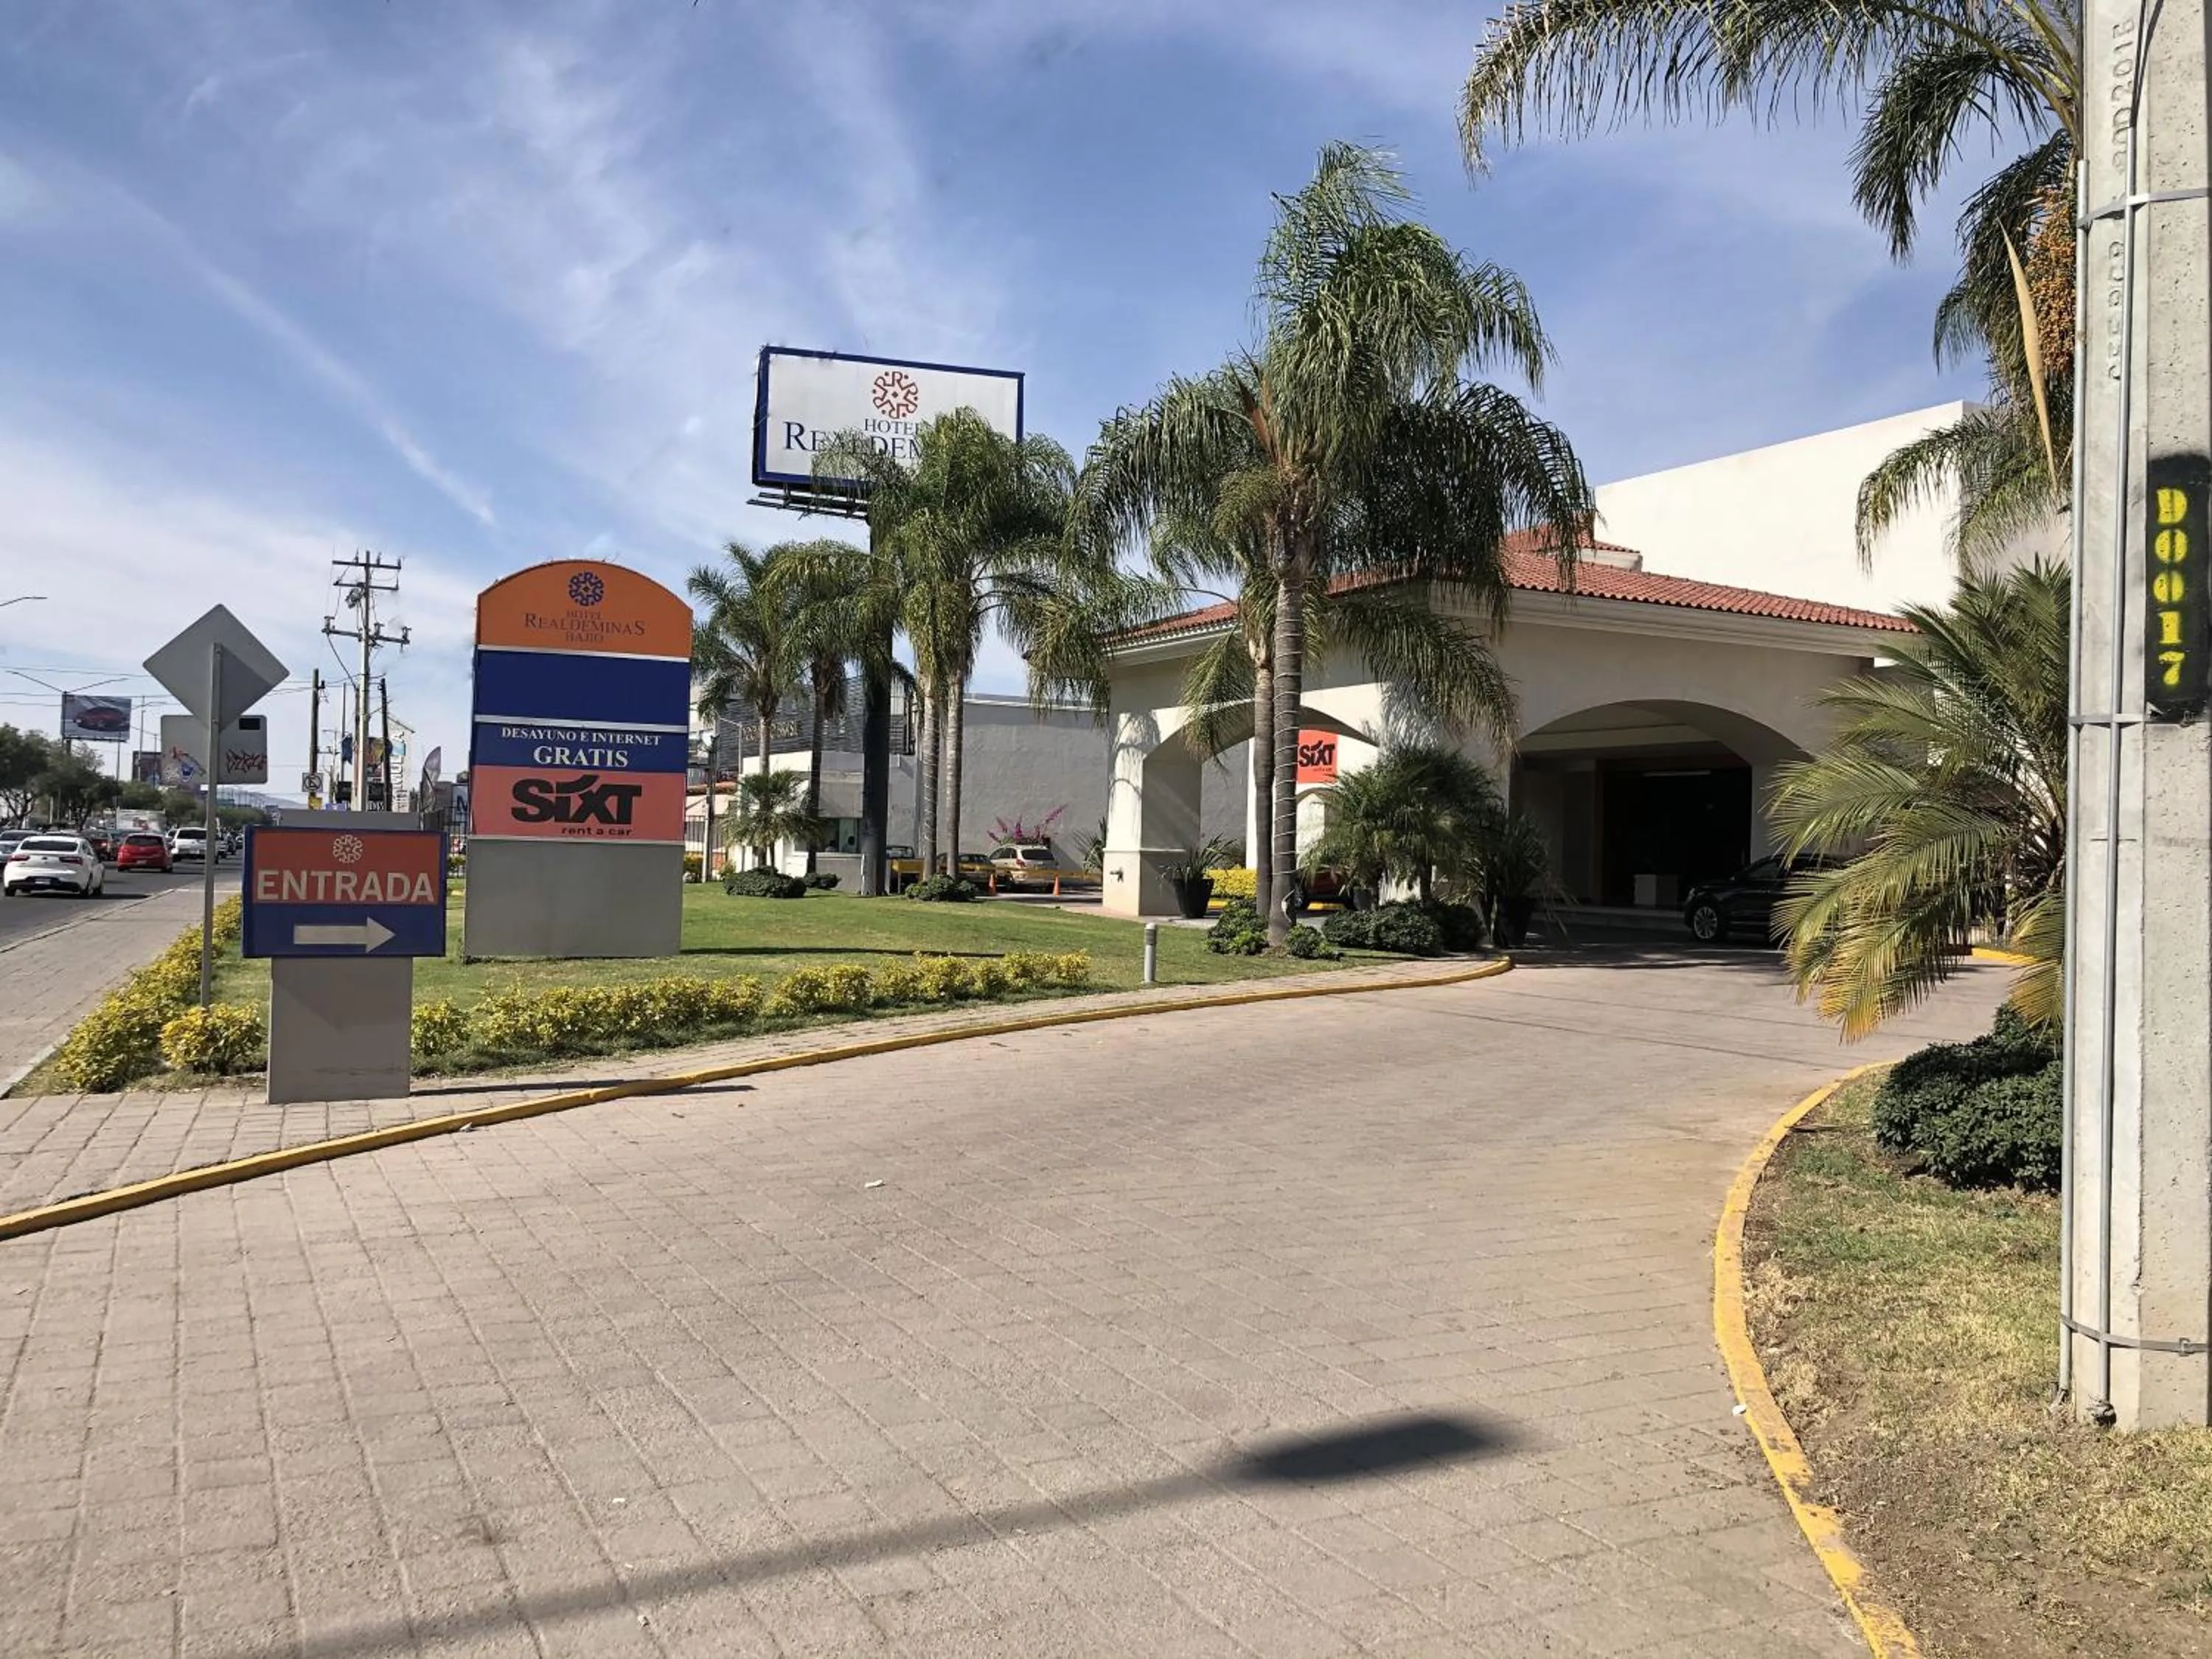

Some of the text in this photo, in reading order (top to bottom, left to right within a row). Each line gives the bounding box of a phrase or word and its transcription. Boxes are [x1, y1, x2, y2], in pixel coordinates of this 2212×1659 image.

[566, 610, 602, 621] HOTEL
[501, 726, 661, 746] DESAYUNO E INTERNET
[533, 745, 629, 768] GRATIS
[562, 827, 633, 836] rent a car
[257, 869, 435, 903] ENTRADA
